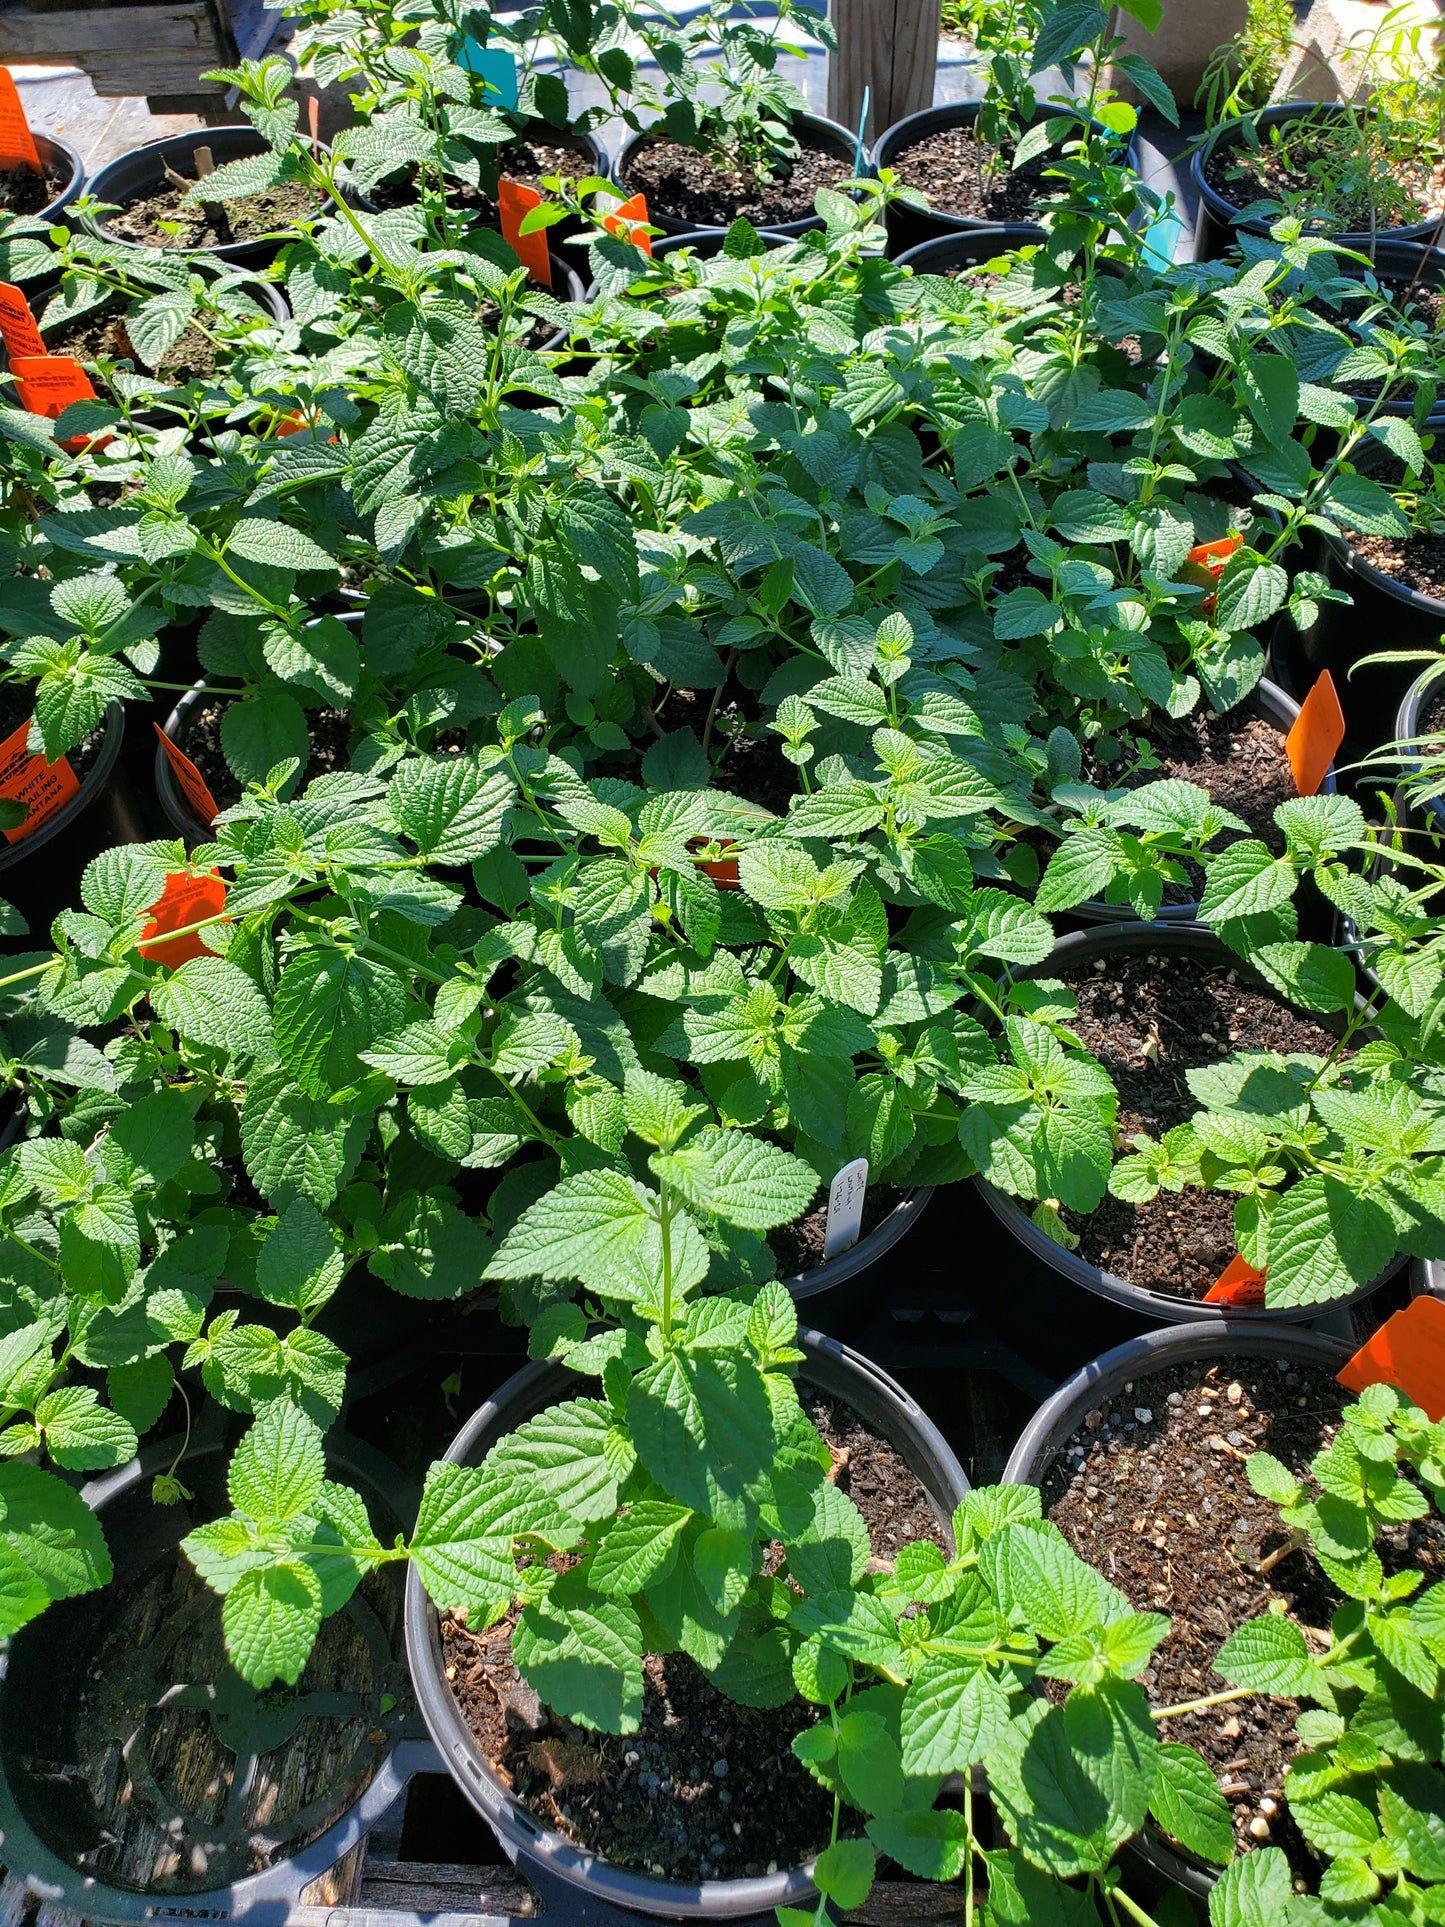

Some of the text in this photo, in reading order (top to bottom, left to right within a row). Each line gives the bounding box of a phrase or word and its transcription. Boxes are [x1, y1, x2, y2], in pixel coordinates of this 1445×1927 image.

[15, 770, 47, 801] WHITE
[28, 774, 58, 806] AILING
[26, 784, 64, 820] ANTANA
